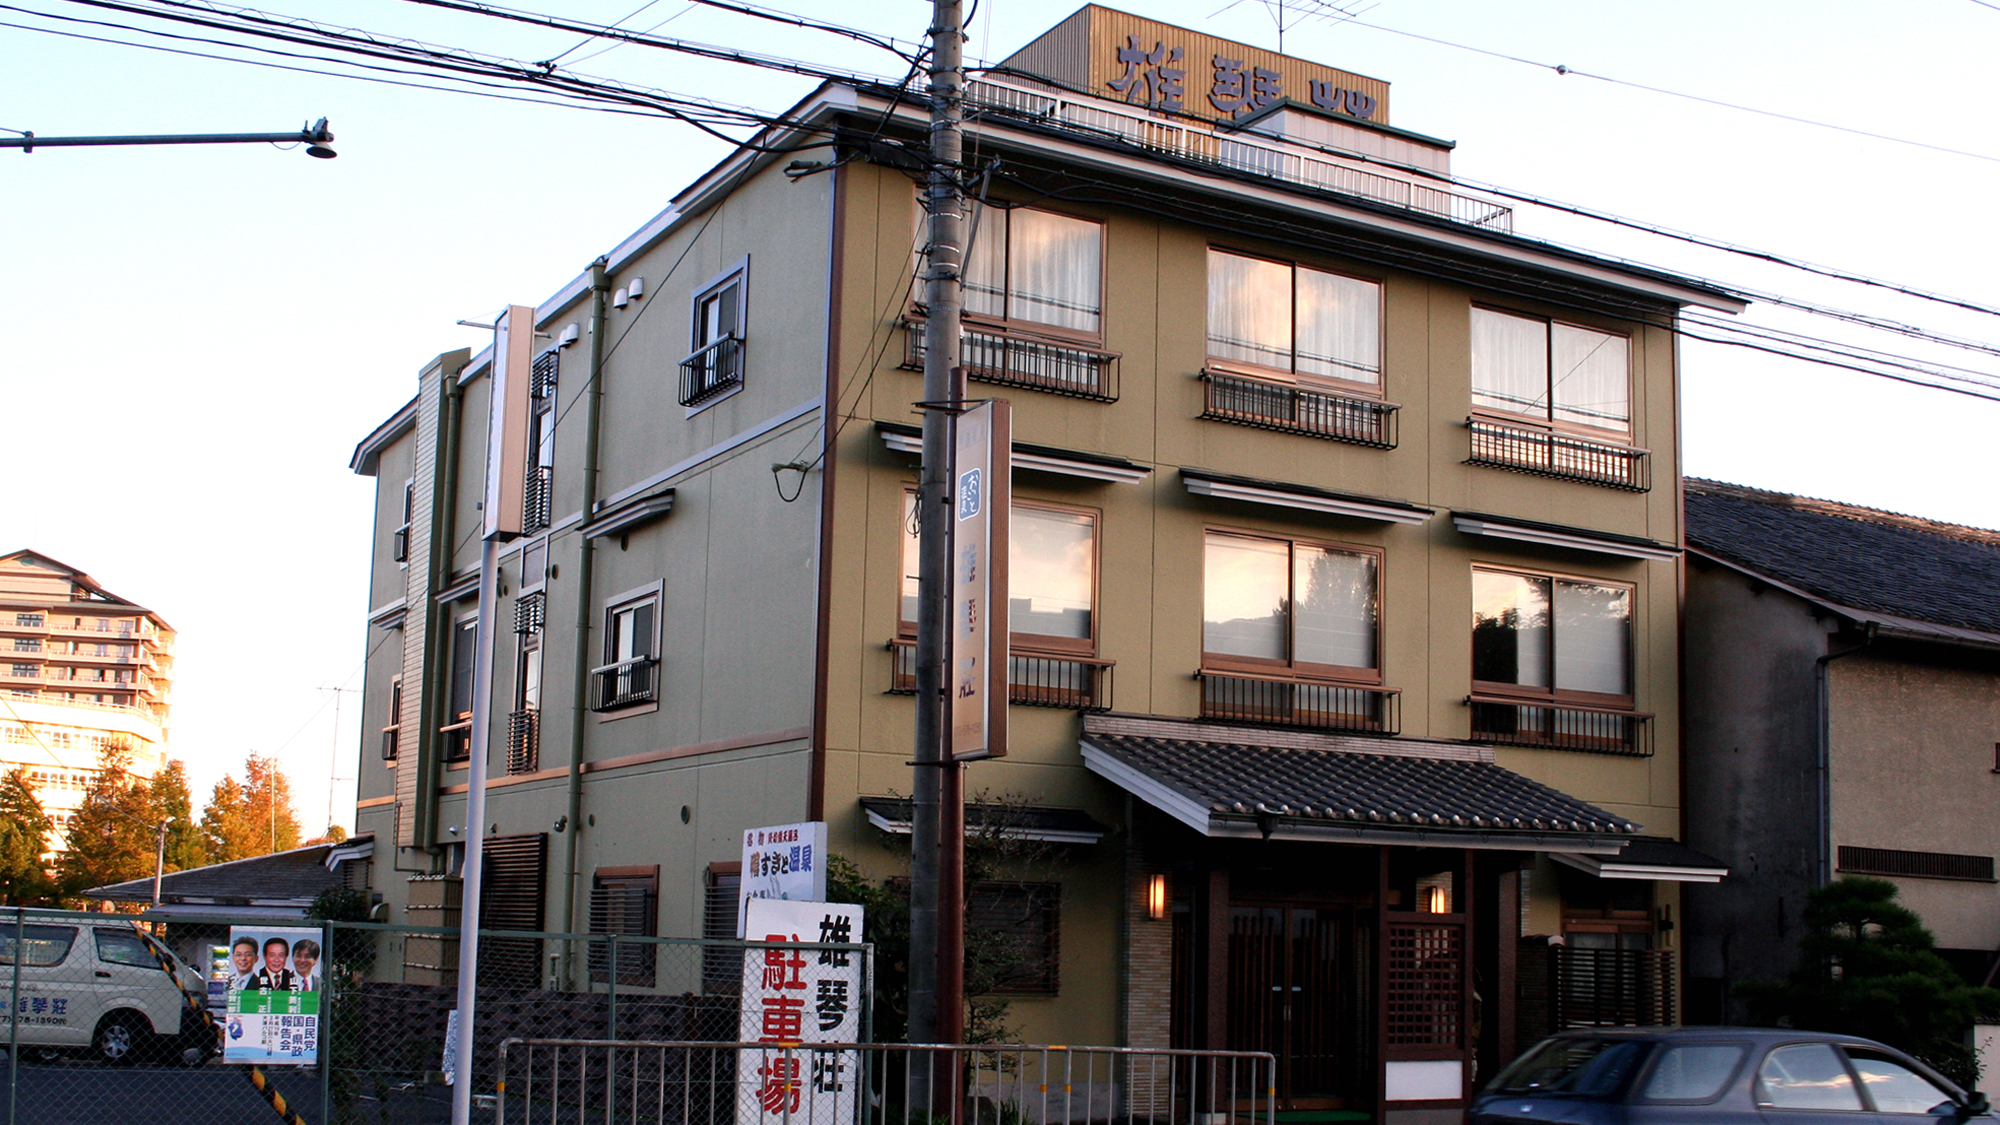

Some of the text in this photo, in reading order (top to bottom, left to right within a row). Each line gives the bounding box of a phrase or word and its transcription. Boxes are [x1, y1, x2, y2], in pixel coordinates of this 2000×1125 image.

[280, 1016, 293, 1051] 報告会
[304, 1016, 316, 1051] 自民党
[756, 934, 807, 1115] 駐車場
[814, 914, 851, 1093] 雄琴荘
